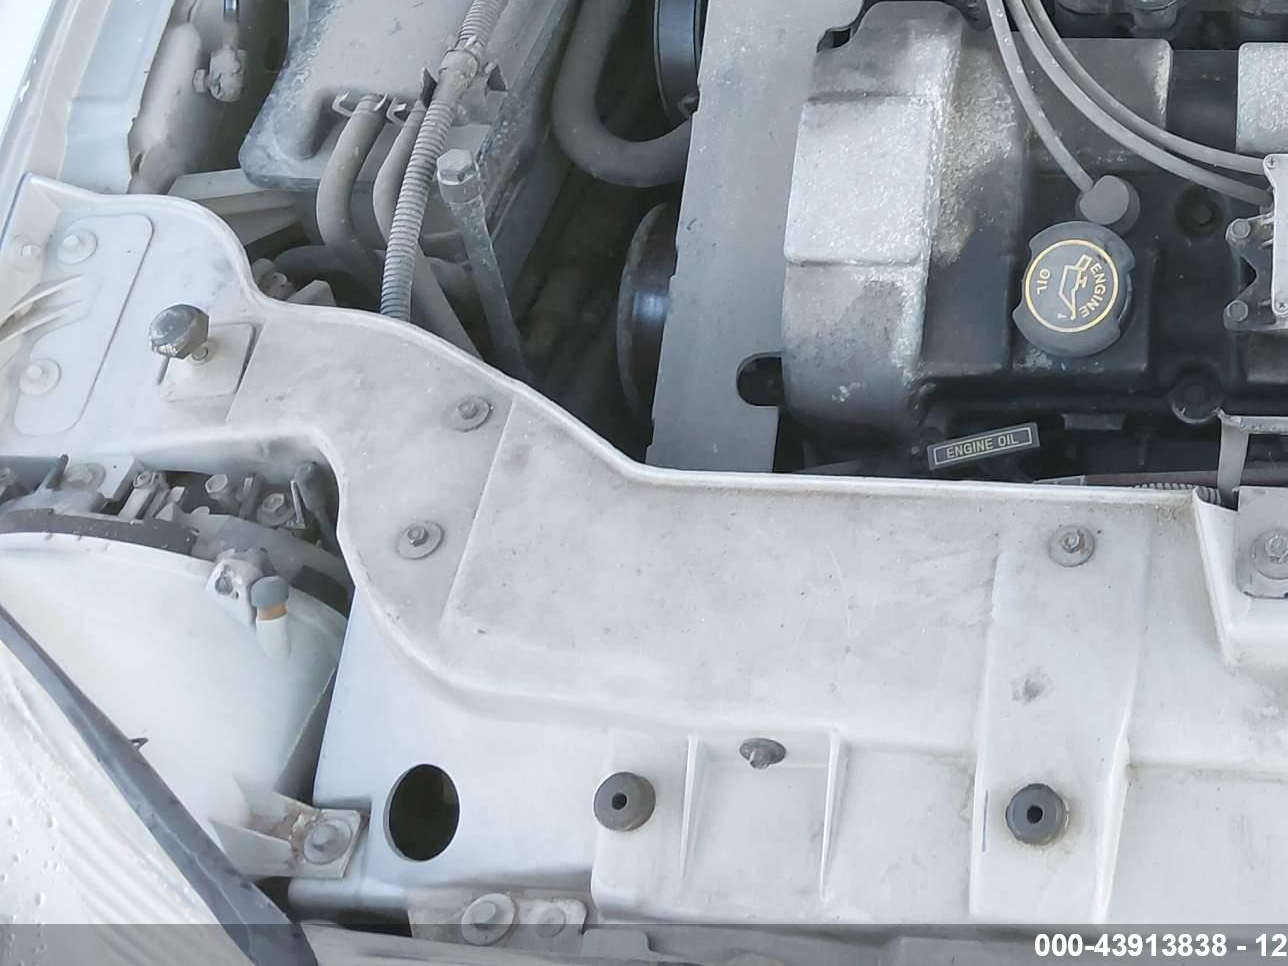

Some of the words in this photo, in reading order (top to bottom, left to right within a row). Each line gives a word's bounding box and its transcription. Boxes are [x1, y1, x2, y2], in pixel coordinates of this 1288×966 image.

[1036, 268, 1050, 295] OIL
[1078, 263, 1106, 318] ENGINE
[946, 438, 994, 459] ENGINE
[998, 433, 1019, 447] OIL
